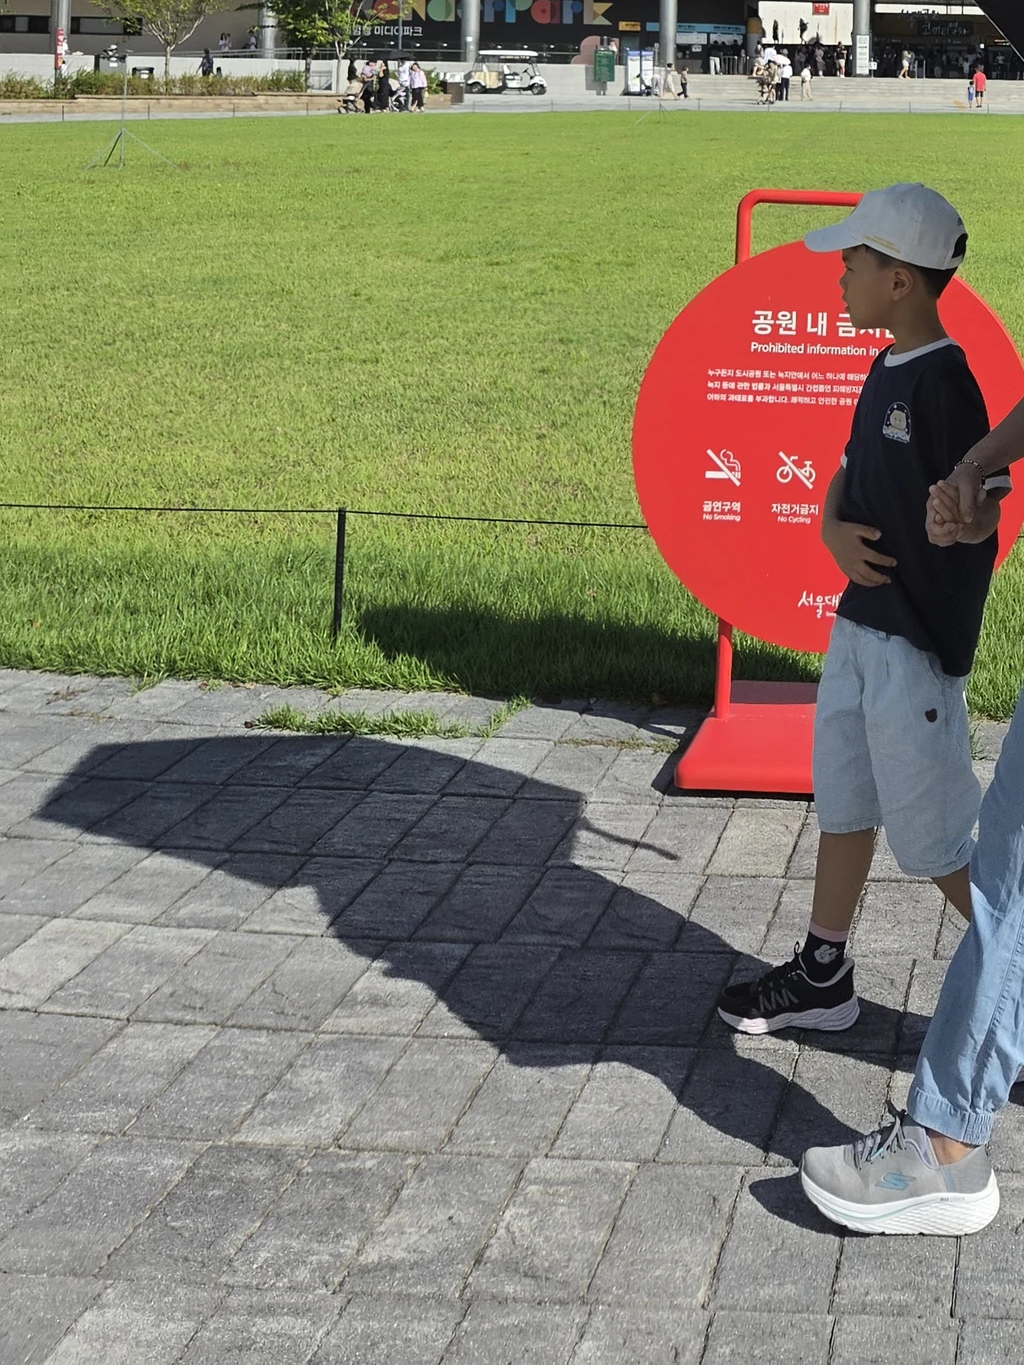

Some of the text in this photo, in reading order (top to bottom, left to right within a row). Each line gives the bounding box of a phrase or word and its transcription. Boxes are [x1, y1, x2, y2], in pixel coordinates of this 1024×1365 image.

[752, 310, 797, 336] 공원
[807, 312, 828, 336] 내
[751, 342, 879, 356] Prohibited information in
[707, 369, 734, 378] 누구든지
[736, 370, 762, 379] 도시공원
[763, 371, 776, 379] 또는
[703, 501, 819, 515] 금연구역 자전거금지
[714, 514, 741, 522] Smoking
[788, 516, 812, 525] Cycling
[797, 590, 843, 619] 서울대
